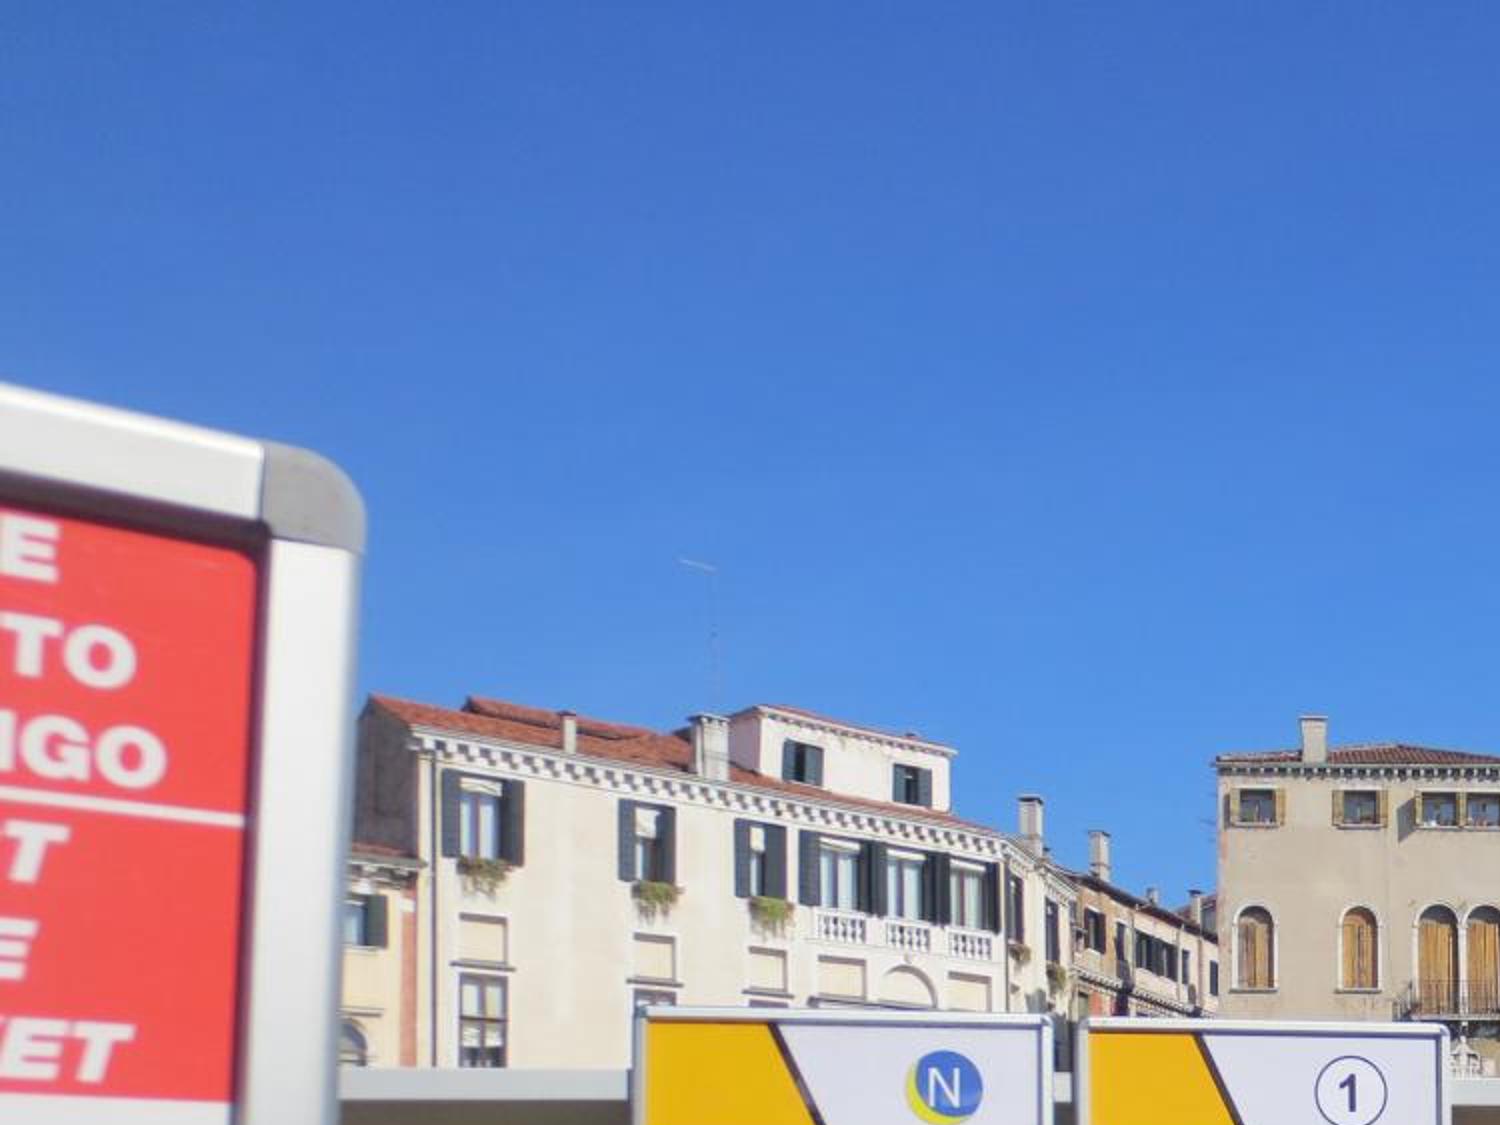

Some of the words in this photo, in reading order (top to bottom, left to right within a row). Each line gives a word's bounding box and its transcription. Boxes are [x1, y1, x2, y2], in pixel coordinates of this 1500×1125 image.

[0, 1014, 136, 1084] ET
[928, 1067, 960, 1108] N
[1339, 1073, 1356, 1112] 1
